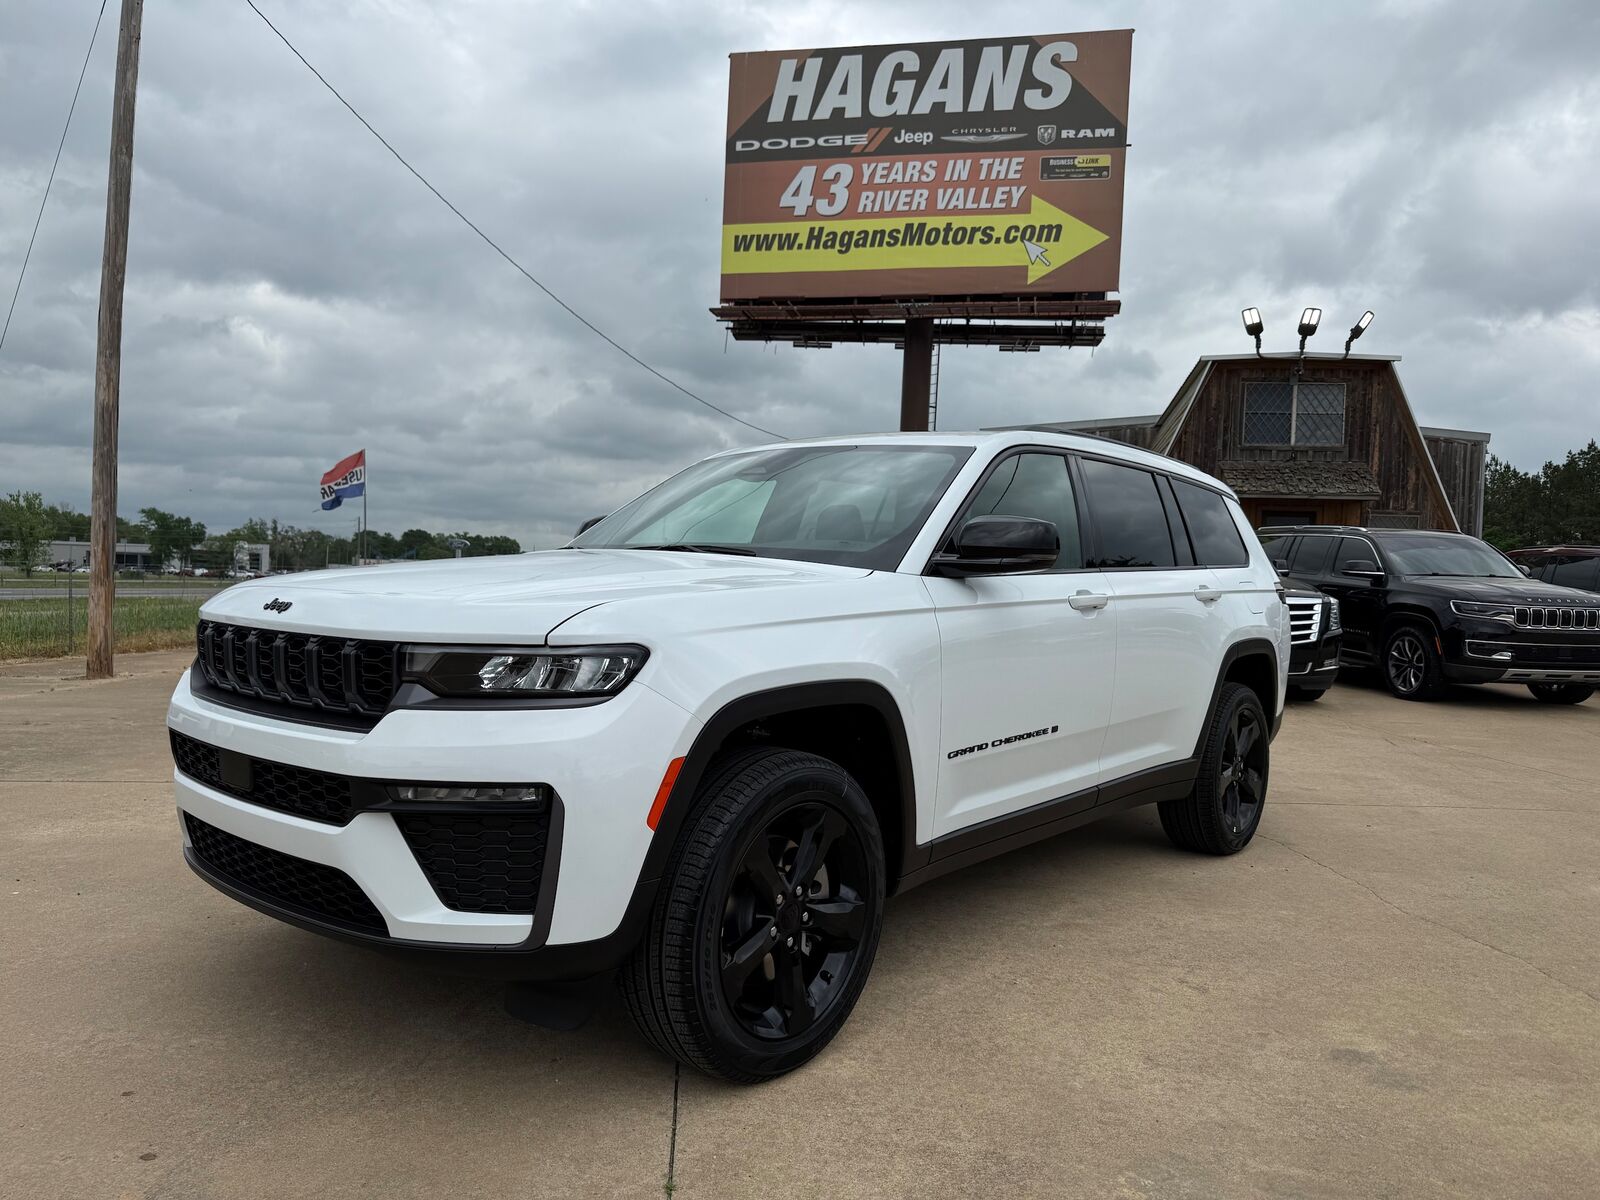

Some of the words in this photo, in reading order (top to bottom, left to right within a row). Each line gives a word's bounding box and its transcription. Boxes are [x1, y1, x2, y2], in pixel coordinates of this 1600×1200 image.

[767, 41, 1078, 123] HAGANS
[735, 133, 868, 151] DODGE
[894, 128, 934, 145] Jeep
[951, 126, 1017, 134] CHRYSLER
[1061, 128, 1115, 139] RAM
[861, 160, 938, 184] YEARS
[944, 159, 972, 182] IN
[979, 157, 1025, 180] THE
[779, 163, 854, 217] 43
[857, 188, 929, 213] RIVER
[936, 186, 1027, 210] VALLEY
[733, 222, 1063, 254] www.HagansMotors.com
[263, 598, 293, 614] Jeep
[947, 743, 989, 759] GRAND
[991, 728, 1049, 747] CHEROKEE
